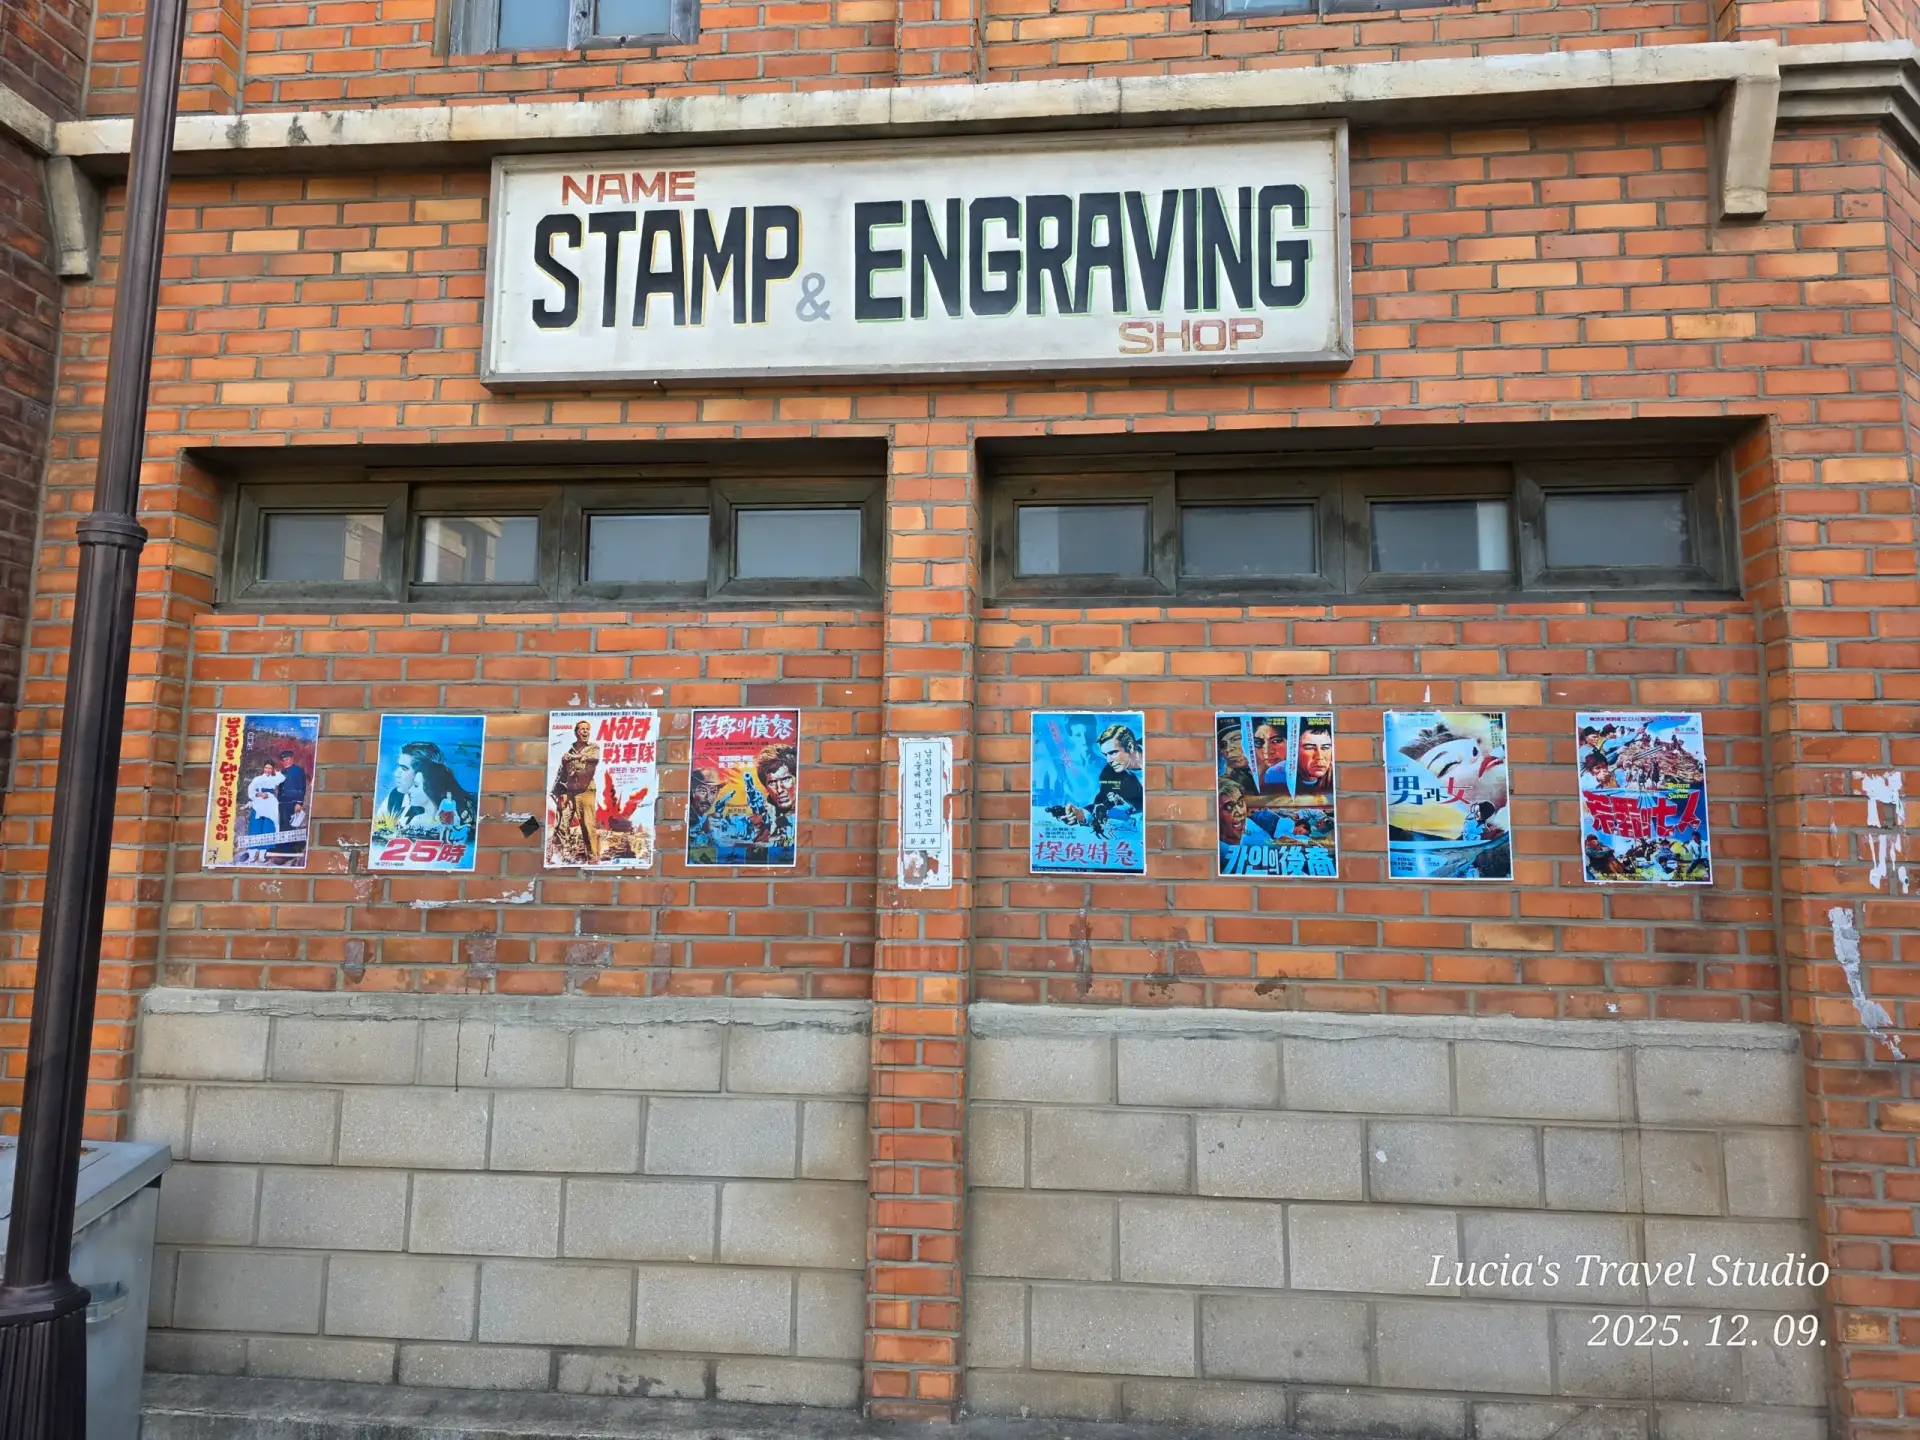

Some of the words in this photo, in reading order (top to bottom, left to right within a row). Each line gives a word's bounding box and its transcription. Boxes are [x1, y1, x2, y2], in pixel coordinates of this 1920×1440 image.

[562, 169, 696, 205] NAME
[532, 205, 803, 330] STAMP
[797, 273, 832, 322] &
[853, 184, 1313, 322] ENGRAVING
[1118, 317, 1264, 355] SHOP
[596, 716, 652, 741] 사하라
